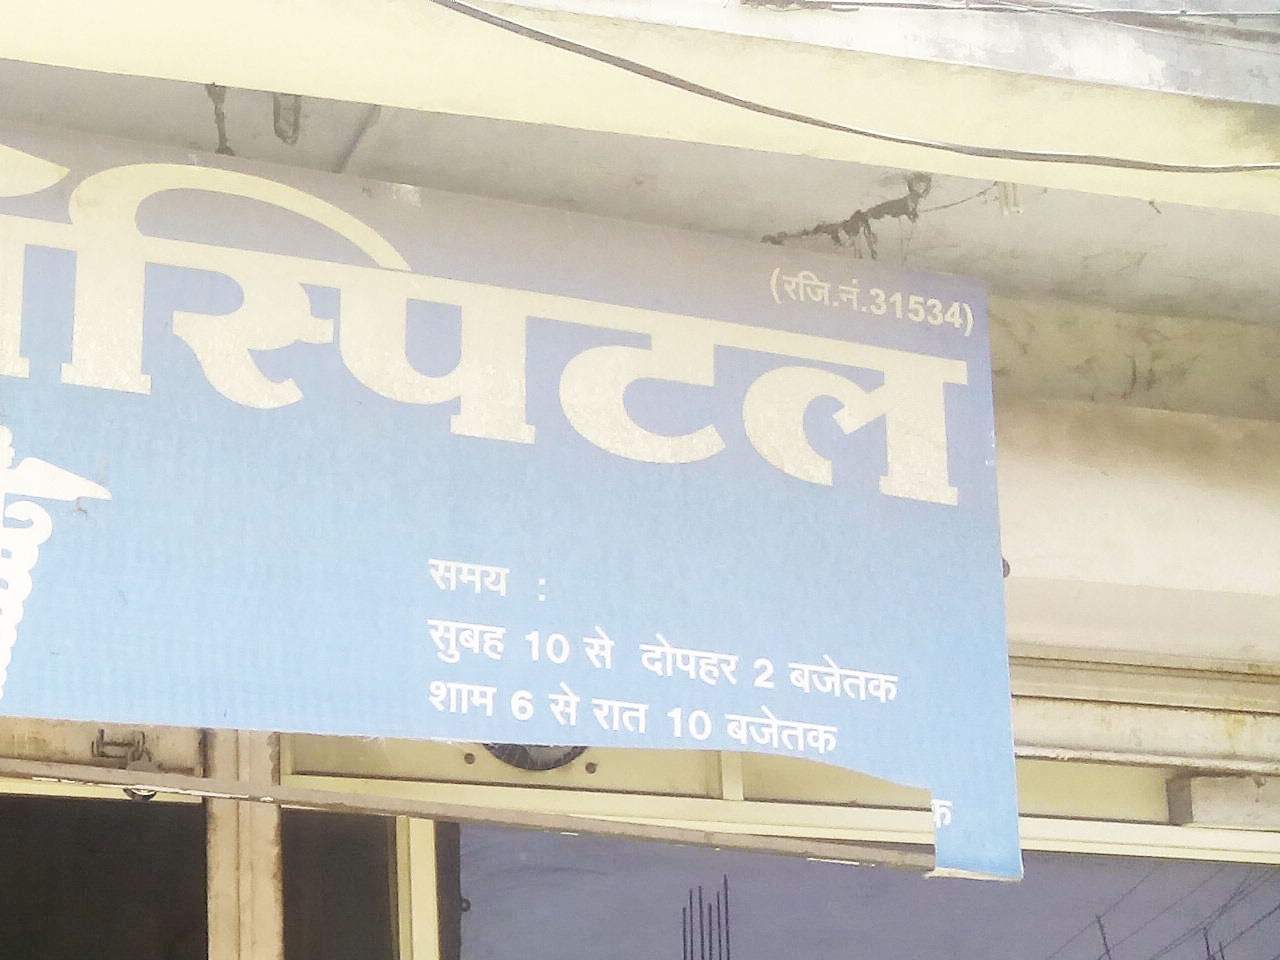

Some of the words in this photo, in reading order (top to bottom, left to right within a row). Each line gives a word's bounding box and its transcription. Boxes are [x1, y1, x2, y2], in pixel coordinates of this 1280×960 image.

[769, 267, 975, 337] (रजि.नं.31534)
[428, 558, 510, 597] समय
[427, 618, 506, 664] सुबह
[525, 630, 571, 664] 10
[583, 625, 615, 670] से
[640, 633, 740, 686] दोपहर
[753, 657, 776, 690] 2
[787, 654, 899, 704] बजेतक
[428, 679, 497, 717] शाम
[510, 690, 534, 722] 6
[549, 681, 580, 727] से
[592, 697, 649, 735] रात
[667, 706, 713, 742] 10
[725, 705, 839, 755] बजेतक
